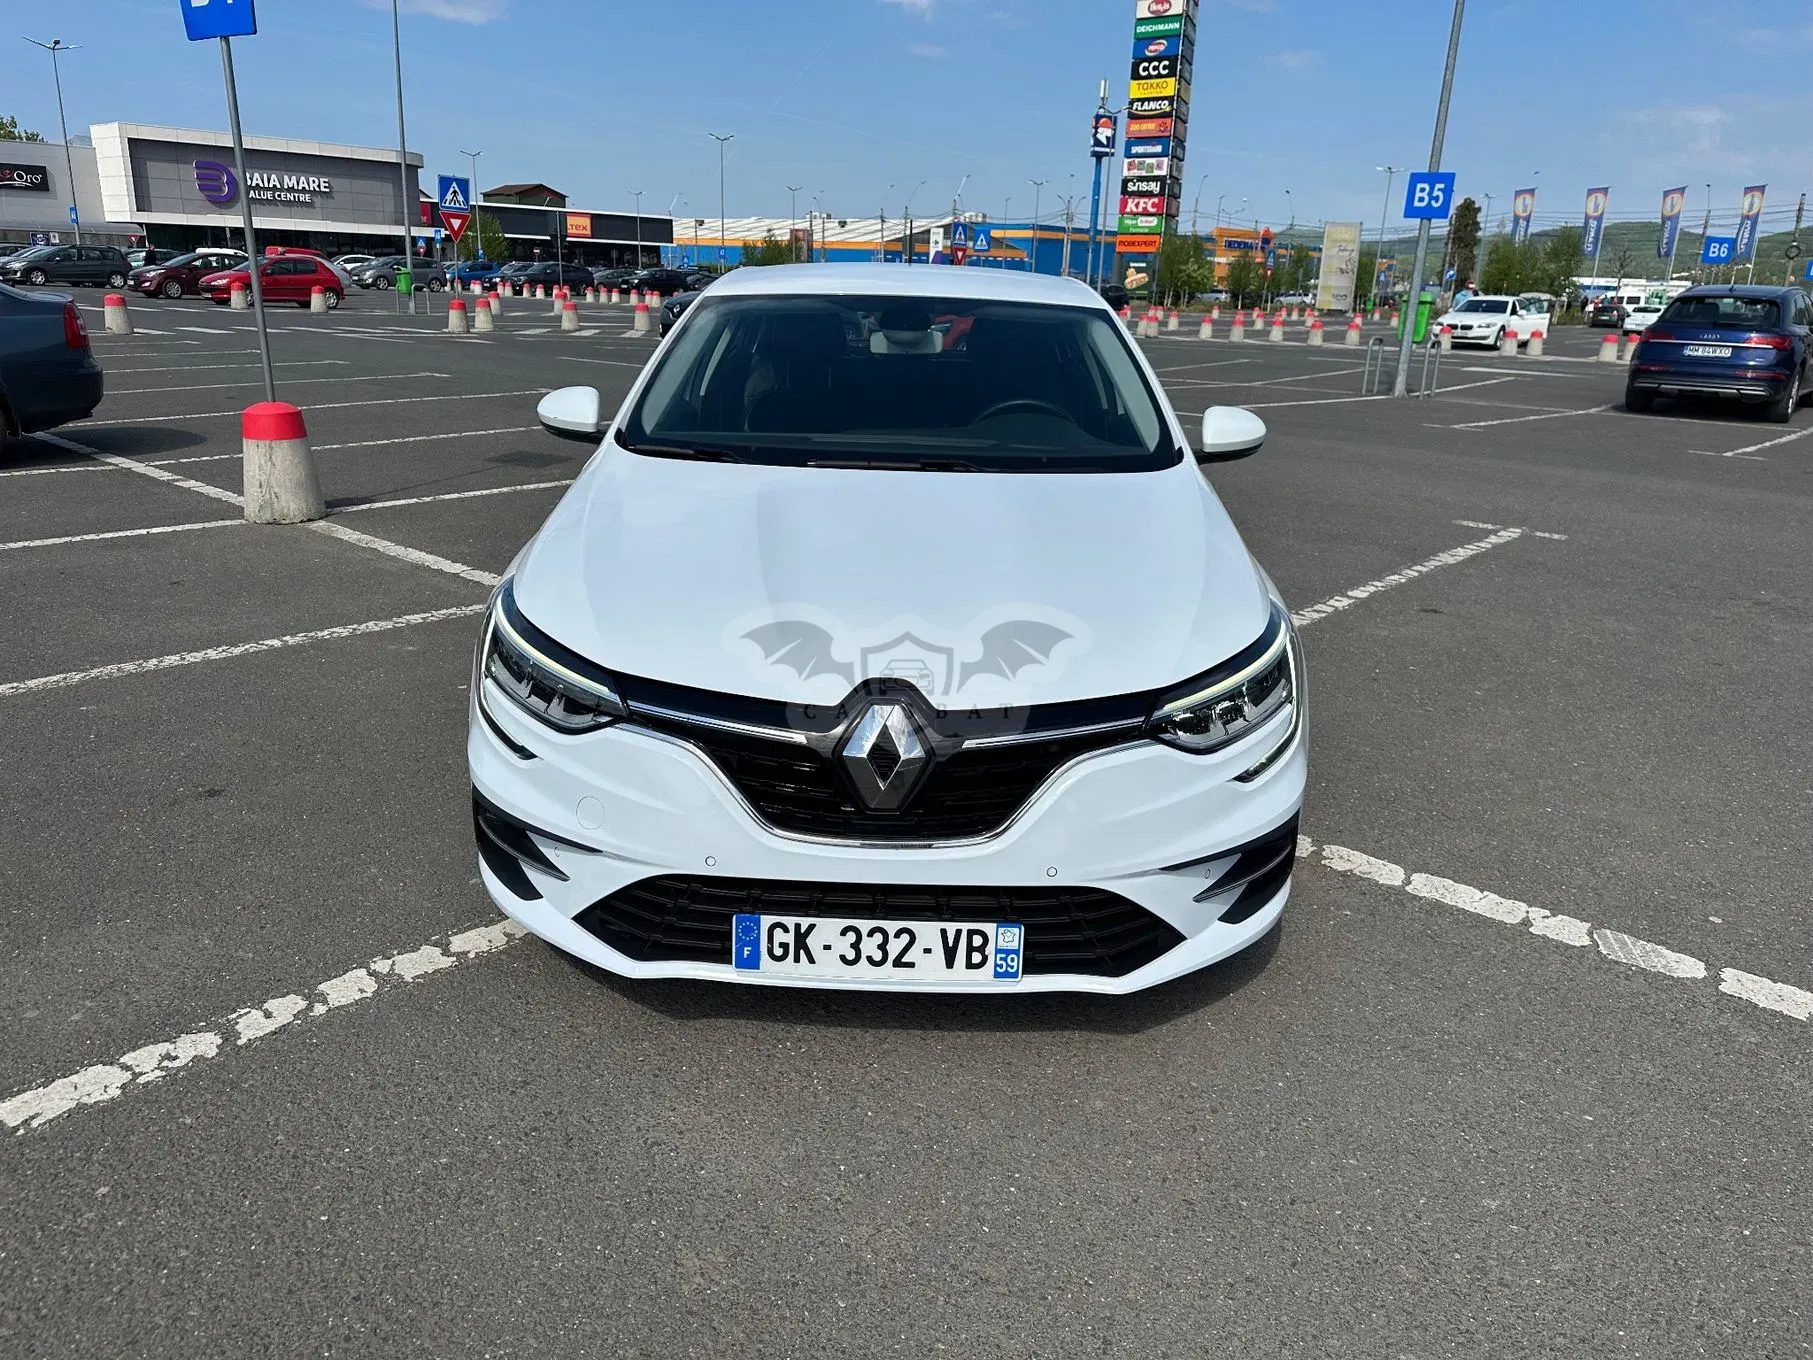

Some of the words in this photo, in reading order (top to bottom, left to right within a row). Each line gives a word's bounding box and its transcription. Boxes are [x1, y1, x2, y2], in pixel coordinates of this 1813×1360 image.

[1136, 22, 1180, 33] DEICHMANN
[1138, 60, 1170, 76] CCC
[1132, 100, 1169, 111] FLANCO
[13, 170, 41, 184] Oro
[283, 174, 331, 192] MARE
[1126, 179, 1161, 194] sinsay
[248, 190, 274, 200] ALUE
[275, 191, 312, 203] CENTRE
[1413, 183, 1445, 208] B5
[1124, 198, 1159, 213] KFC
[1118, 240, 1157, 248] MOBEXPERT
[1708, 243, 1729, 257] B6
[743, 946, 752, 959] F
[766, 921, 990, 970] GK-332-VB
[995, 953, 1018, 973] 59
